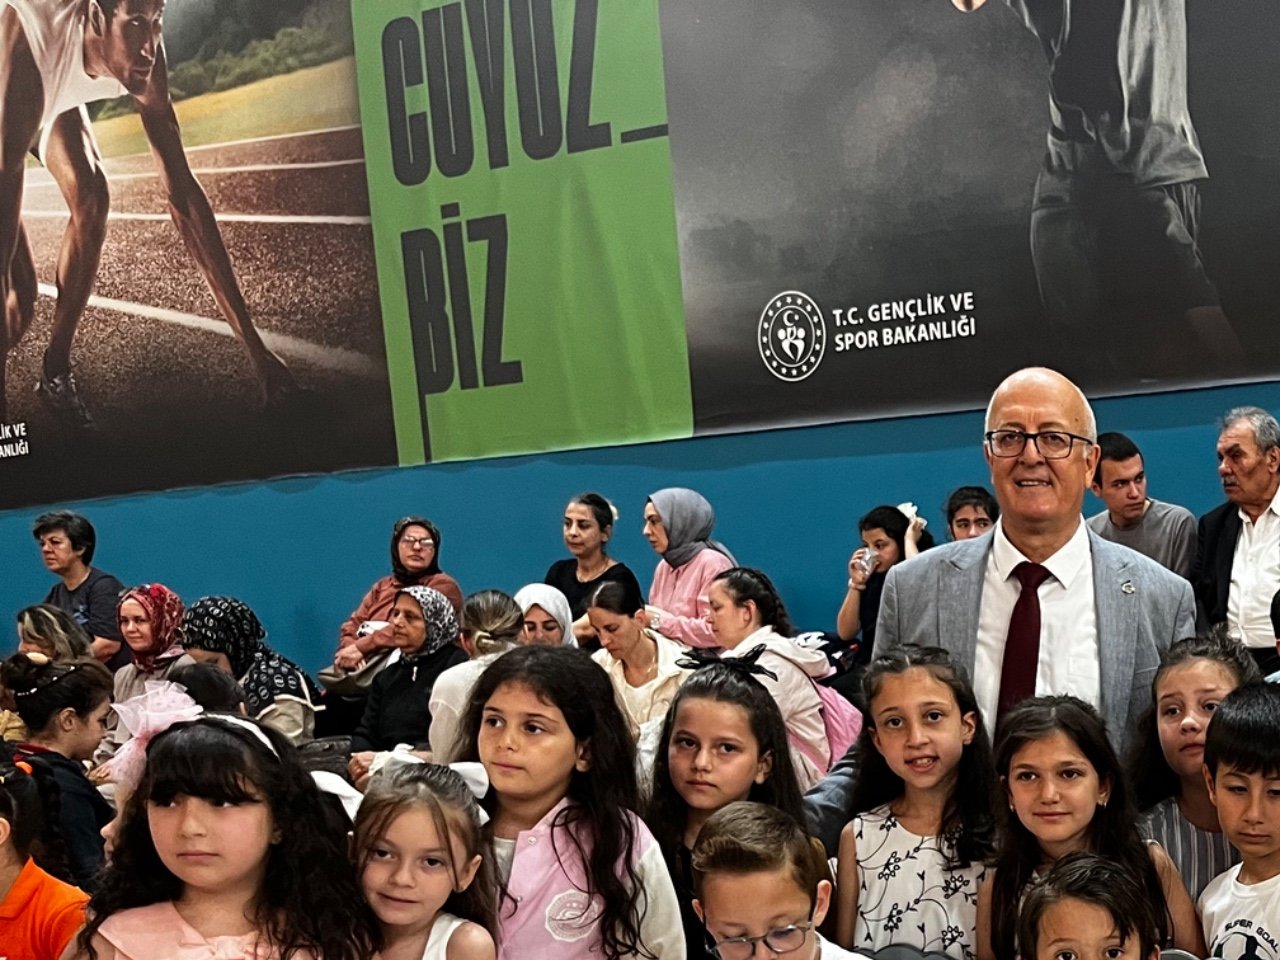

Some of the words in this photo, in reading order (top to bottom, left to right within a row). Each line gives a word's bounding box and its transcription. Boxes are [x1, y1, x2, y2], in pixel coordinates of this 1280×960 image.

[832, 308, 864, 327] T.C.
[868, 293, 945, 323] GENÇLİK
[950, 292, 974, 312] VE
[835, 327, 879, 352] SPOR
[882, 315, 976, 347] BAKANLIĞI
[13, 422, 27, 438] VE
[1256, 926, 1279, 954] GOAL
